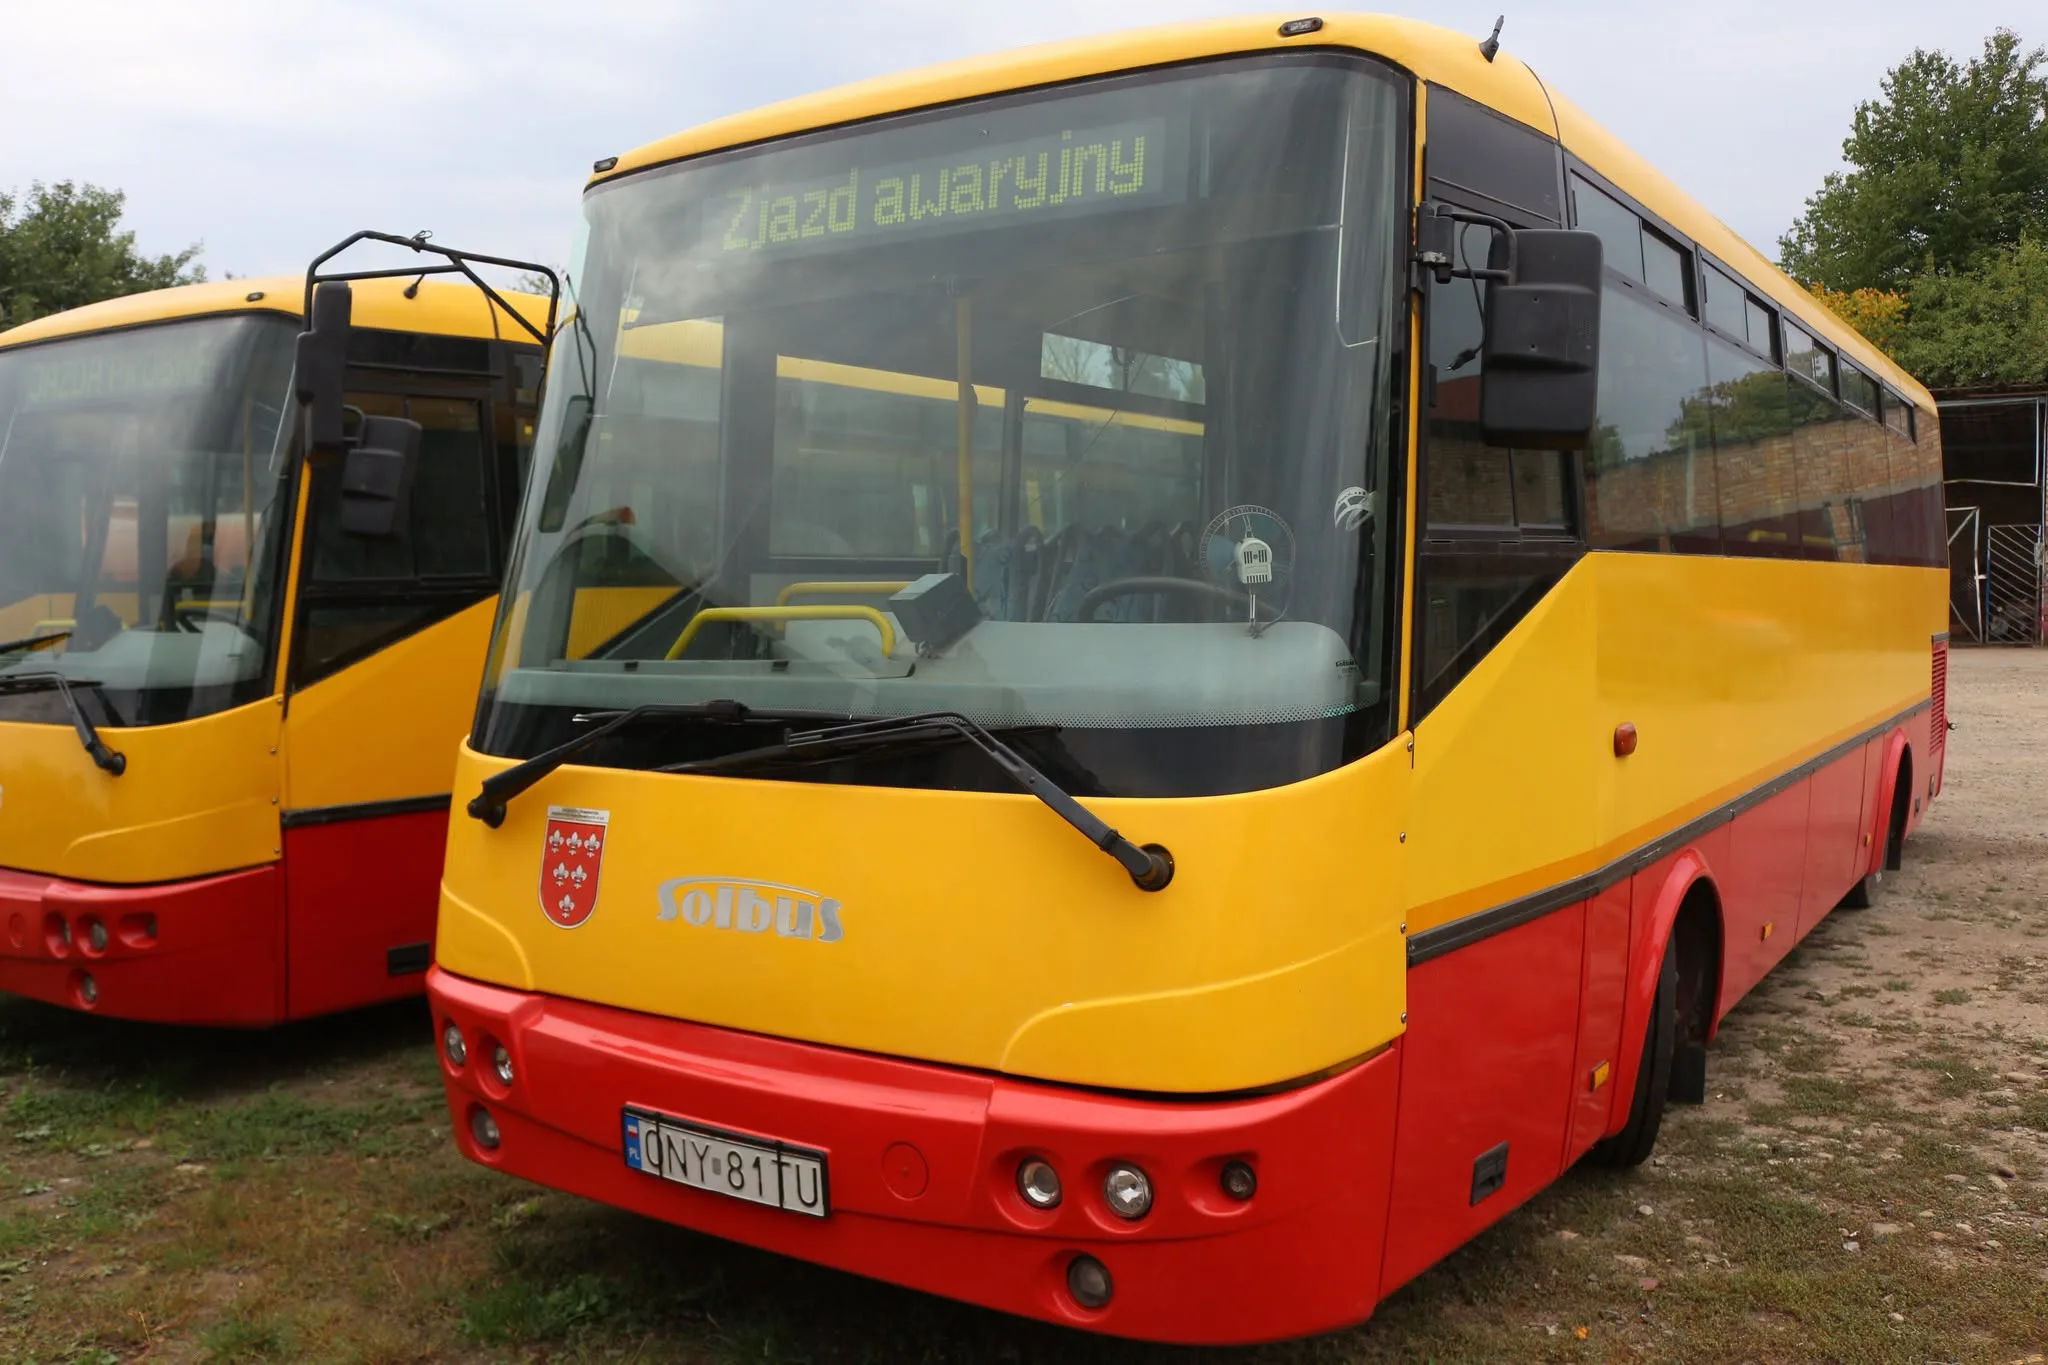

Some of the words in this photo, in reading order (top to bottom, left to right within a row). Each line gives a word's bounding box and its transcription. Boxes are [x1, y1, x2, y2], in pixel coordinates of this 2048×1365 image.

[723, 168, 860, 251] Zjazd
[874, 131, 1145, 225] awaryjny
[656, 875, 845, 943] Solbus
[727, 1151, 818, 1207] 81TU
